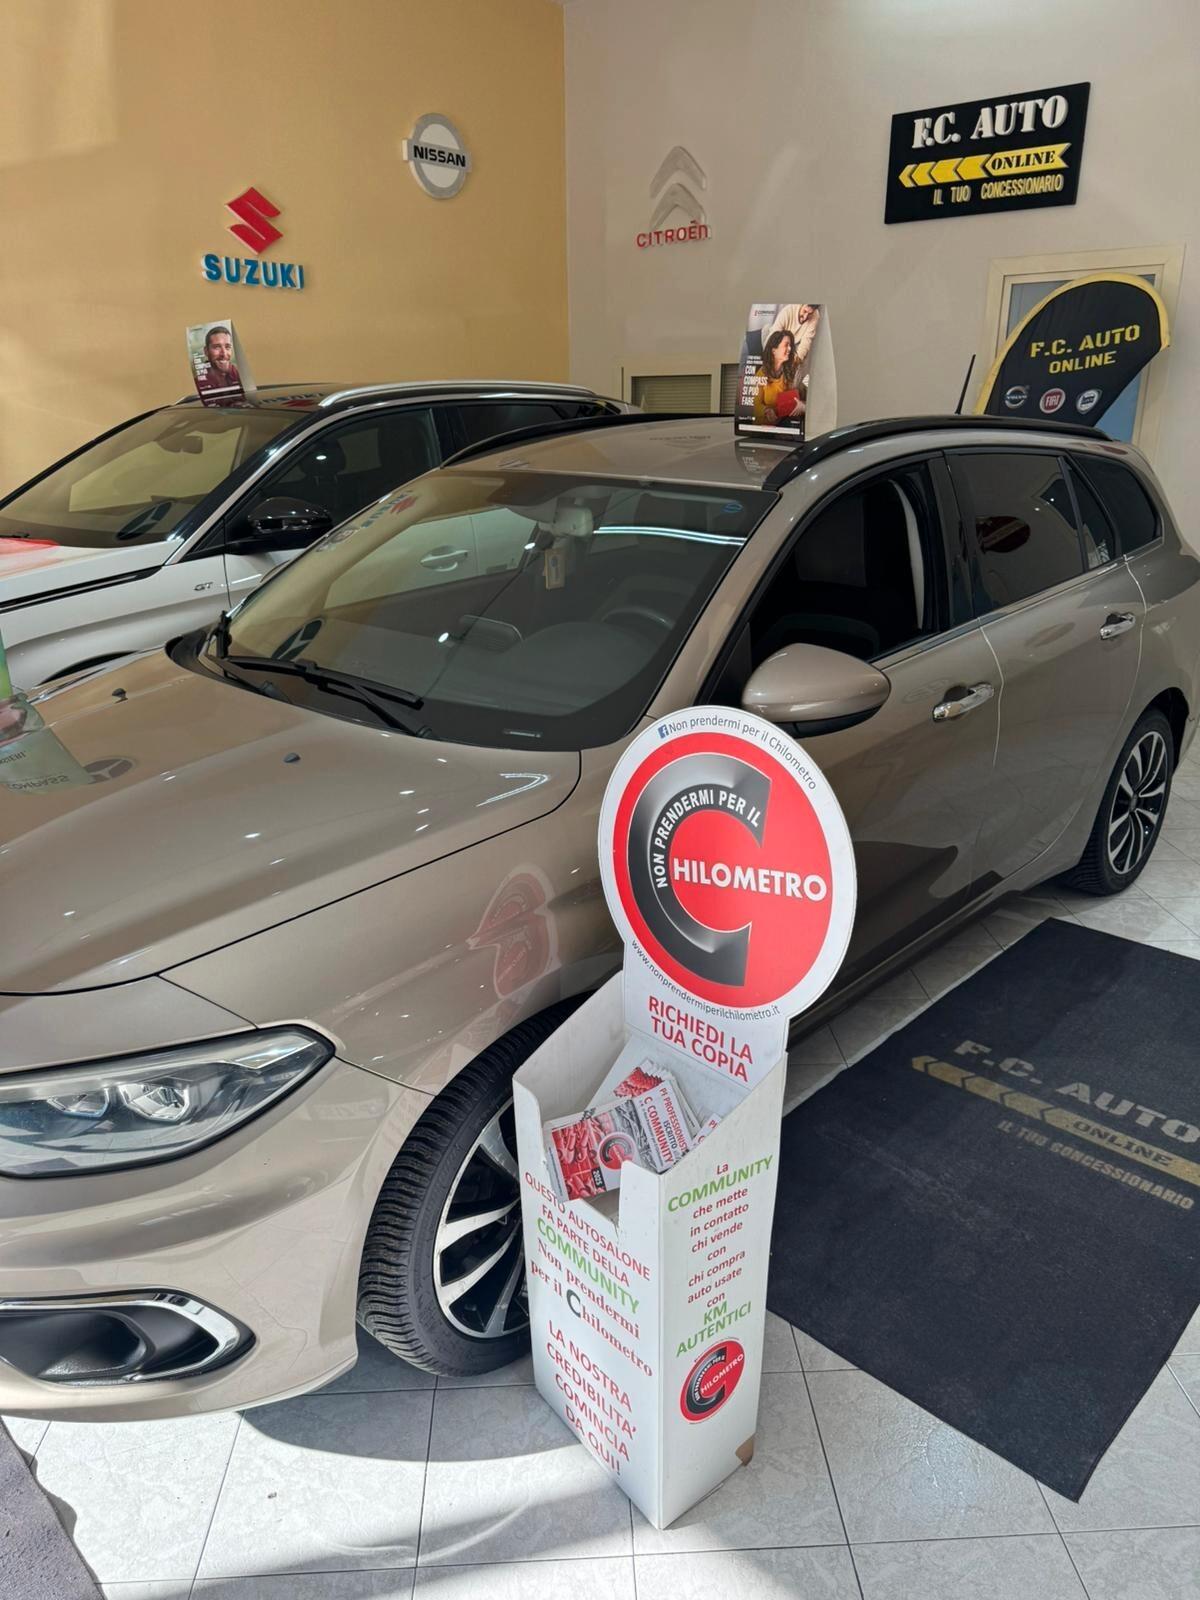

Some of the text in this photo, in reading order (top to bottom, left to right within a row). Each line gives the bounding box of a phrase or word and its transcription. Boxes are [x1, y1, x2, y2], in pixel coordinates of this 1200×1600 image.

[912, 95, 1069, 149] F.C. AUTO
[413, 145, 466, 168] NISSAN
[991, 150, 1056, 171] ONLINE
[933, 174, 1064, 205] IL TUO CONCESSIONARIO
[201, 254, 304, 289] SUZUKI
[1030, 324, 1141, 358] F.C. AUTO
[1048, 350, 1117, 374] ONLINE
[743, 376, 768, 386] COMPASS
[744, 365, 757, 375] CON
[669, 715, 817, 790] Non prendermi per il Chilometro
[653, 789, 761, 888] NON PRENDERMI PER IL
[631, 940, 780, 1021] www.nonprendermiperilchilometro.it
[649, 996, 753, 1064] RICHIEDI LA
[651, 1015, 748, 1082] TUA COPIA
[954, 1040, 1200, 1143] F.C. AUTO
[647, 1105, 673, 1162] COMMUNITY
[1072, 1120, 1174, 1167] ONLINE
[667, 1154, 773, 1213] COMMUNITY
[716, 1163, 729, 1175] La
[996, 1120, 1195, 1210] IL TUO CONCESSIONARIO
[525, 1171, 565, 1214] QUESTO
[568, 1210, 651, 1281] AUTOSALONE
[690, 1203, 749, 1238] in contatto
[693, 1188, 748, 1219] che mette
[542, 1204, 630, 1287] FA PARTE DELLA
[691, 1221, 743, 1253] chi vende
[707, 1246, 726, 1261] con
[537, 1217, 640, 1314] COMMUNITY
[537, 1238, 640, 1340] Non prendermi
[687, 1267, 742, 1304] auto usate
[688, 1250, 746, 1287] chi compra
[530, 1260, 653, 1377] per il Chilometro
[703, 1301, 728, 1325] KM
[706, 1291, 725, 1308] con
[676, 1301, 752, 1358] AUTENTICI
[547, 1342, 637, 1440] CREDIBILITA'
[548, 1320, 632, 1412] LA NOSTRA
[555, 1373, 630, 1462] COMINCIA
[565, 1405, 621, 1475] DA QUI!
